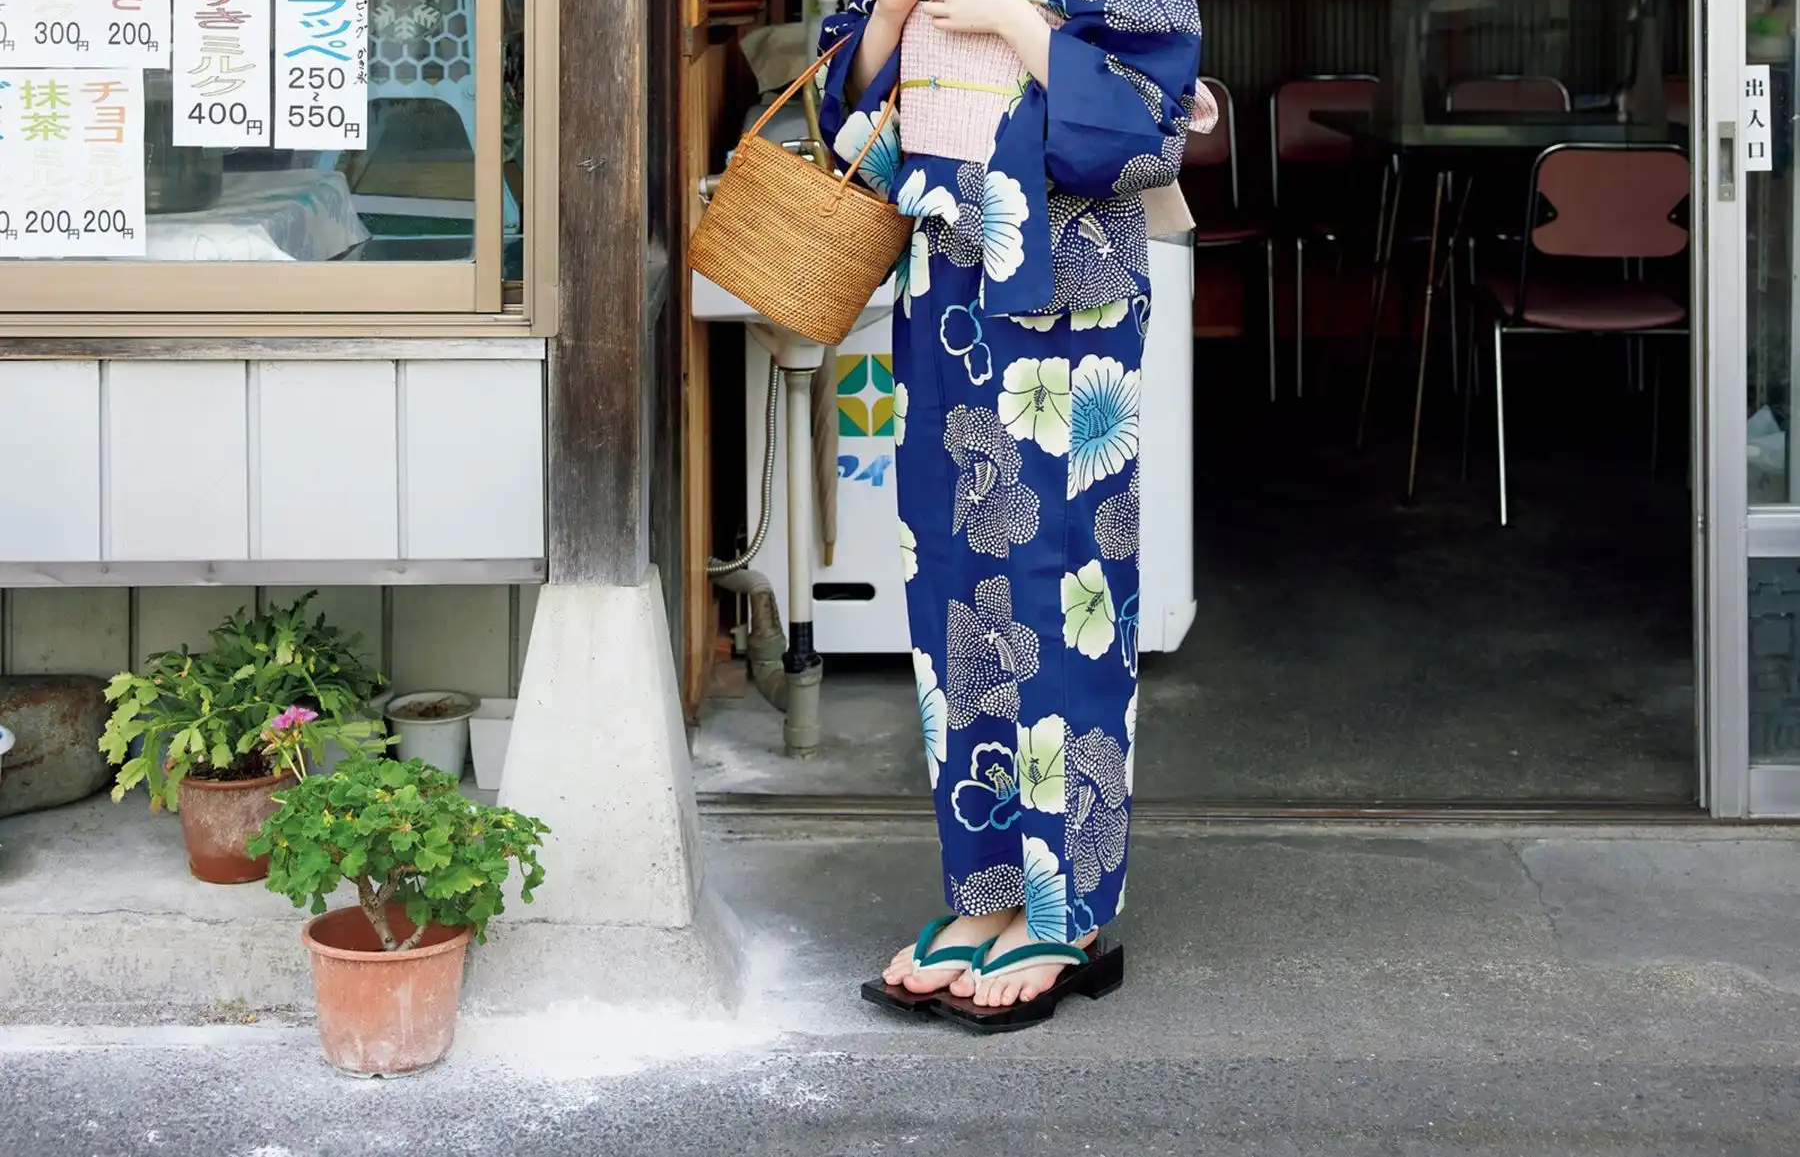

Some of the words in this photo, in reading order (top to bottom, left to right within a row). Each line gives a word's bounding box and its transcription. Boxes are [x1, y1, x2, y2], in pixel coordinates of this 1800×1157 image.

[34, 21, 89, 51] 300円
[108, 22, 159, 52] 200円
[288, 67, 346, 90] 250
[188, 102, 263, 136] 400円
[288, 105, 360, 138] 550円
[1745, 78, 1765, 159] 出入口
[25, 210, 80, 240] 200円
[83, 210, 134, 240] 200円
